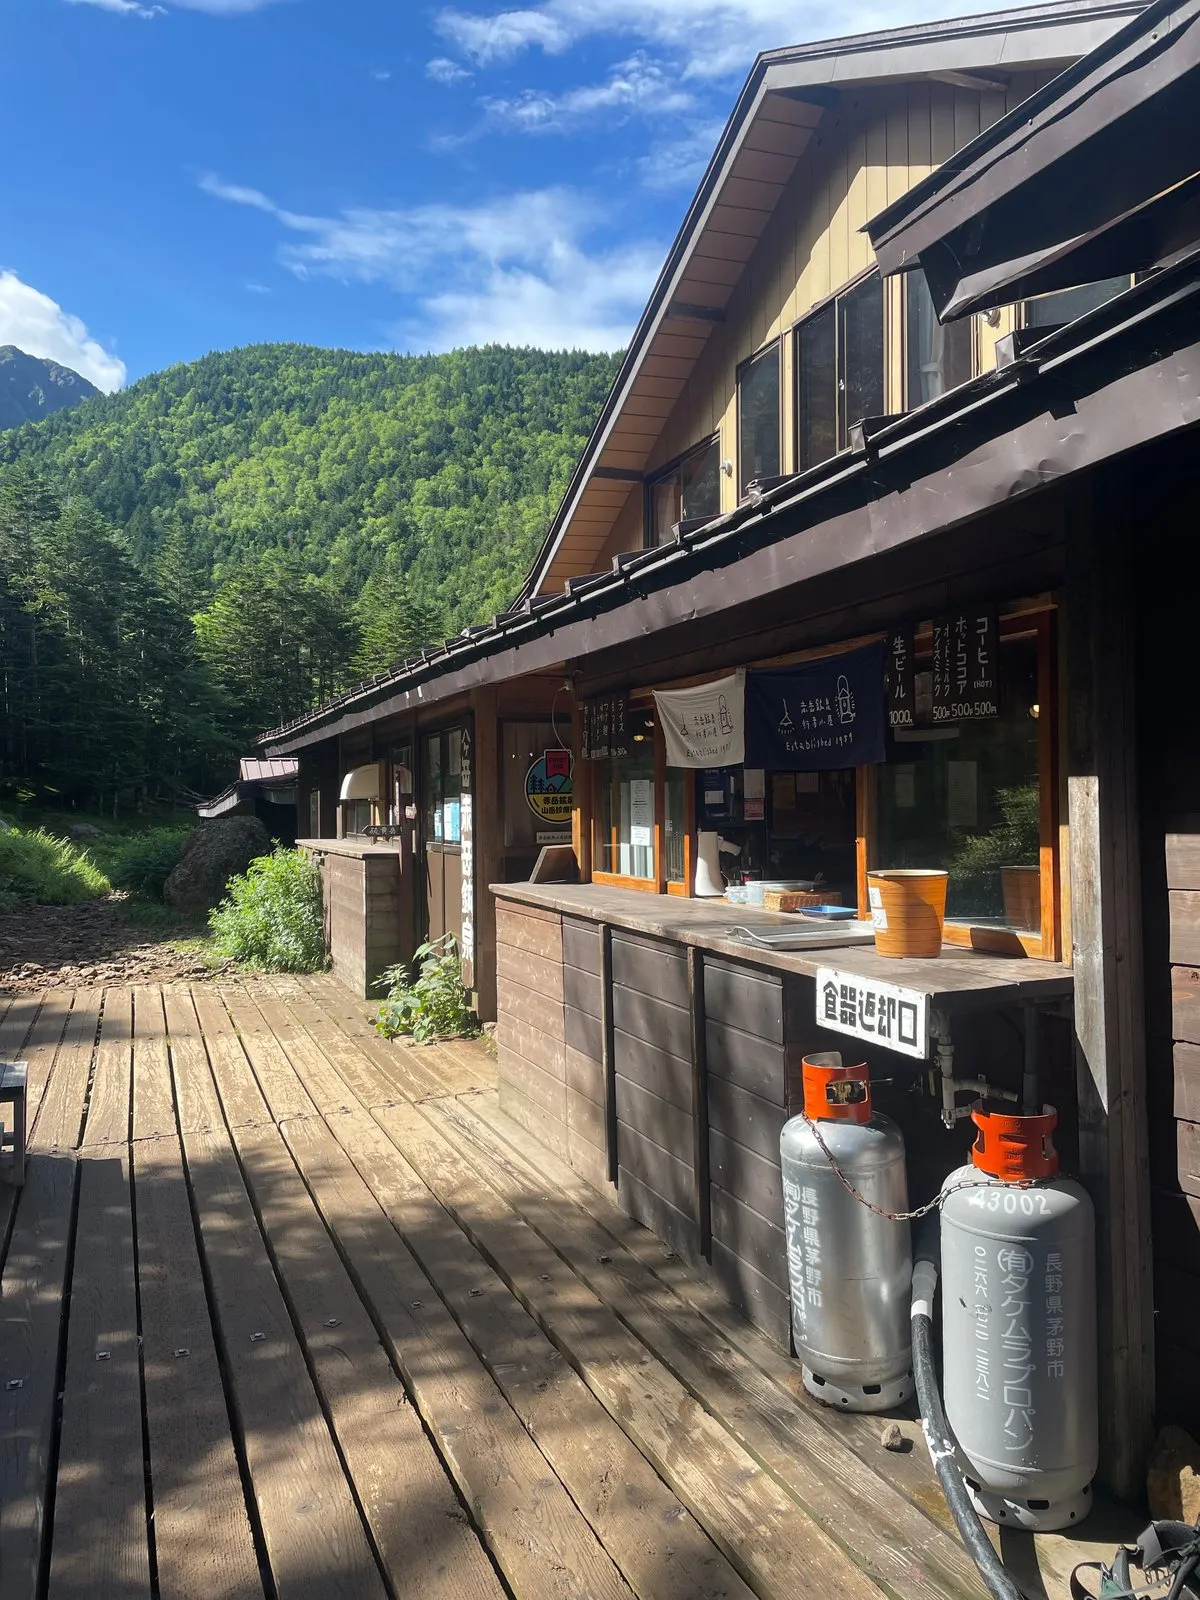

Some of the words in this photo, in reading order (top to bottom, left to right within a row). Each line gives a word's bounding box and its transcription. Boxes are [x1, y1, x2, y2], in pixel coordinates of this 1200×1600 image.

[892, 635, 906, 699] 生ビール
[976, 616, 989, 679] コーヒー
[785, 737, 832, 751] Established
[823, 980, 918, 1048] 食器返却口
[1045, 1252, 1065, 1379] 長野県茅野市
